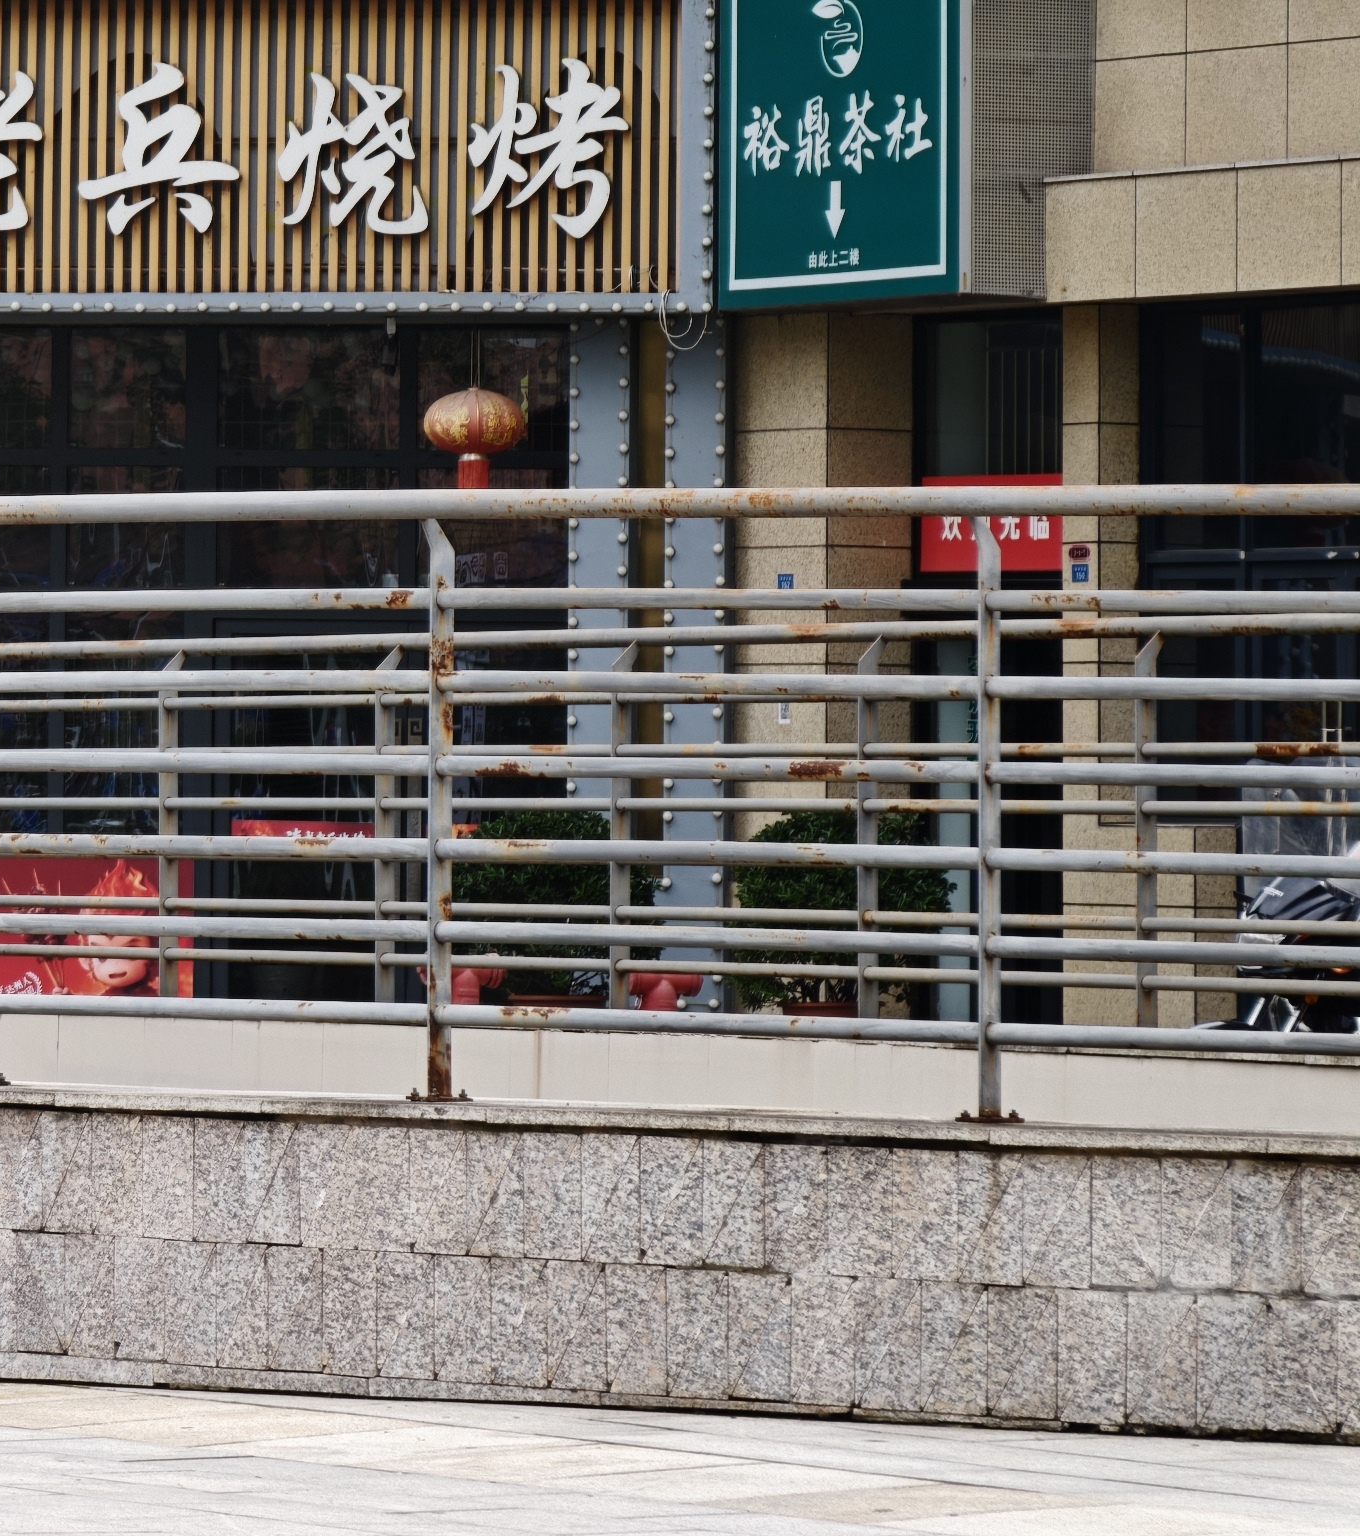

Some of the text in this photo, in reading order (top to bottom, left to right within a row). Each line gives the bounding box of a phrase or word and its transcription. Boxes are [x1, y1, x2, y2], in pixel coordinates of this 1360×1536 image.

[742, 89, 933, 177] 裕鼎茶社
[941, 516, 1050, 542] 欢光临
